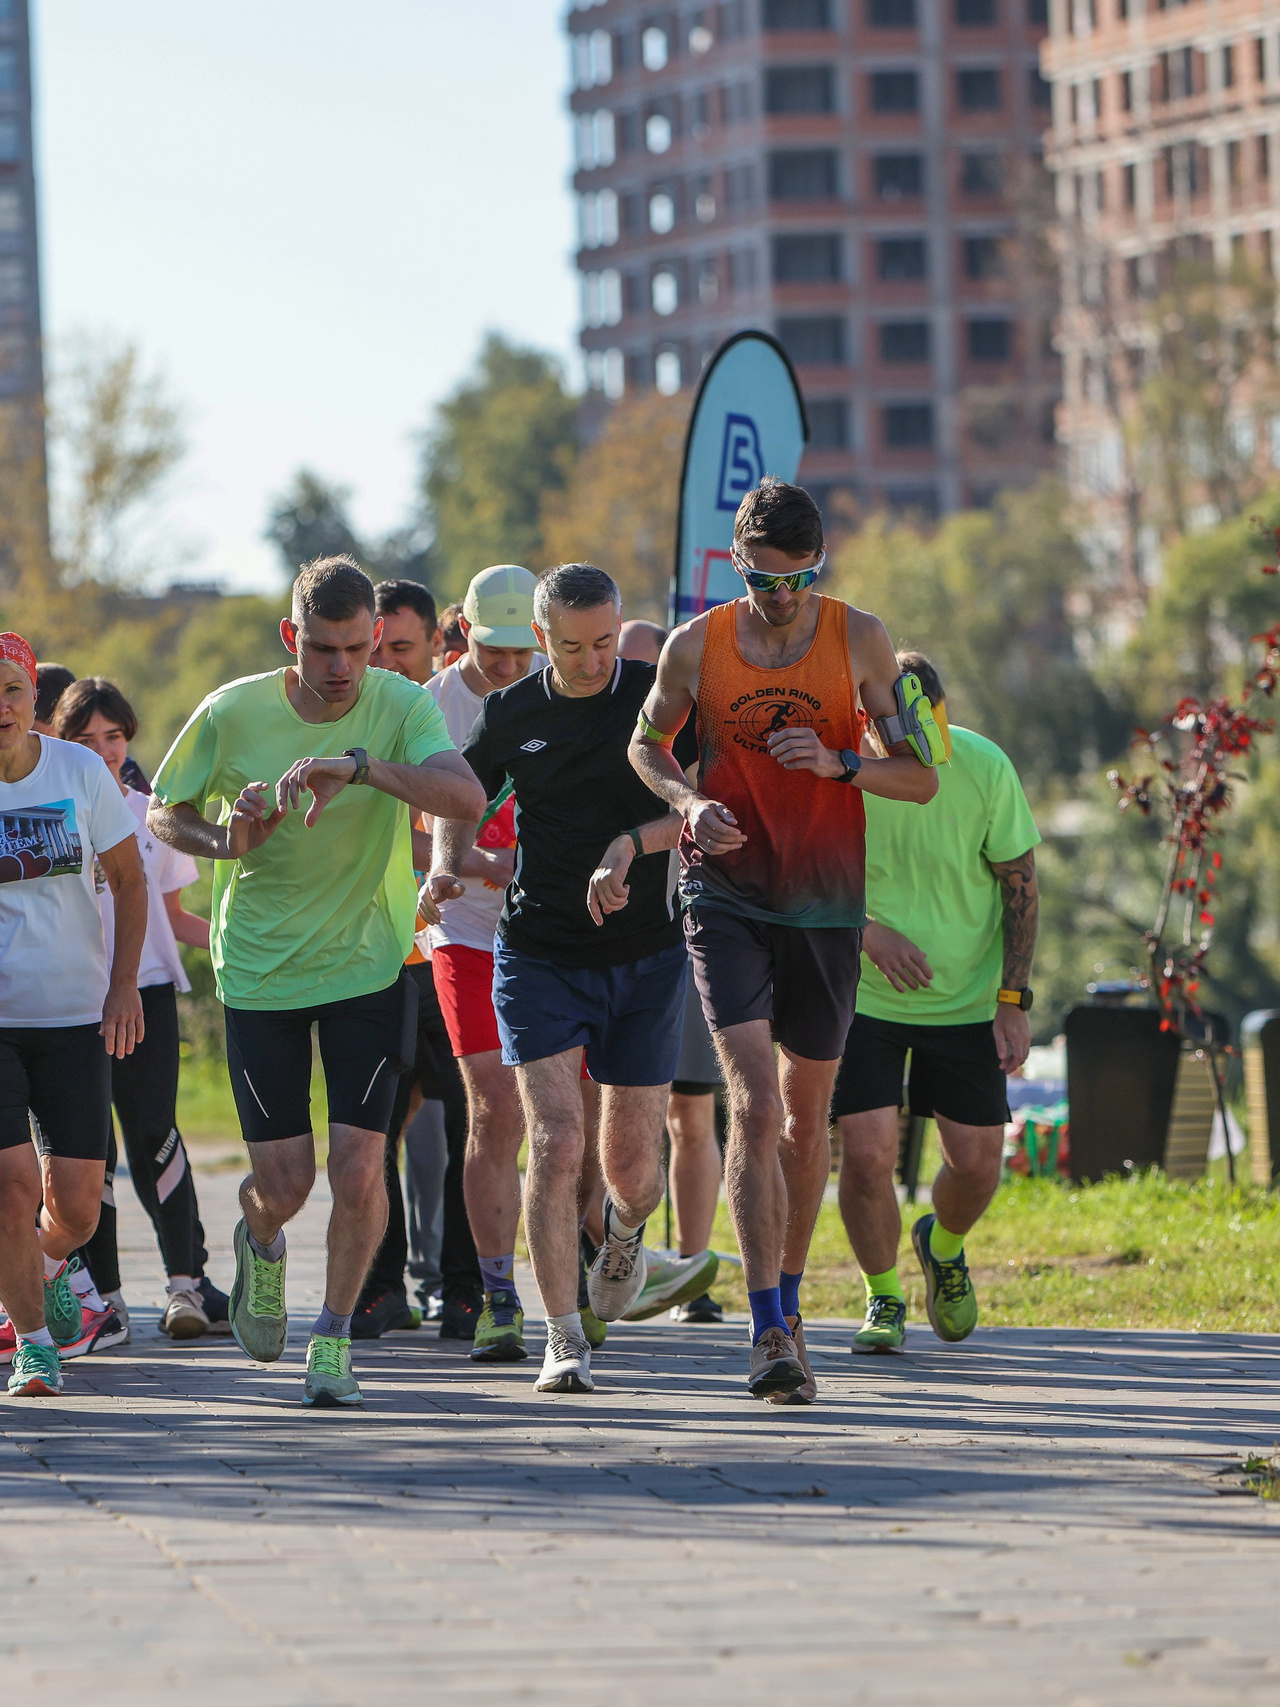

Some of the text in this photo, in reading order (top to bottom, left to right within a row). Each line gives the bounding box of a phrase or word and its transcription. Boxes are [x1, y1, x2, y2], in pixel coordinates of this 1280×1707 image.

[730, 687, 822, 712] GOLDEN RING
[733, 733, 771, 755] ULTR
